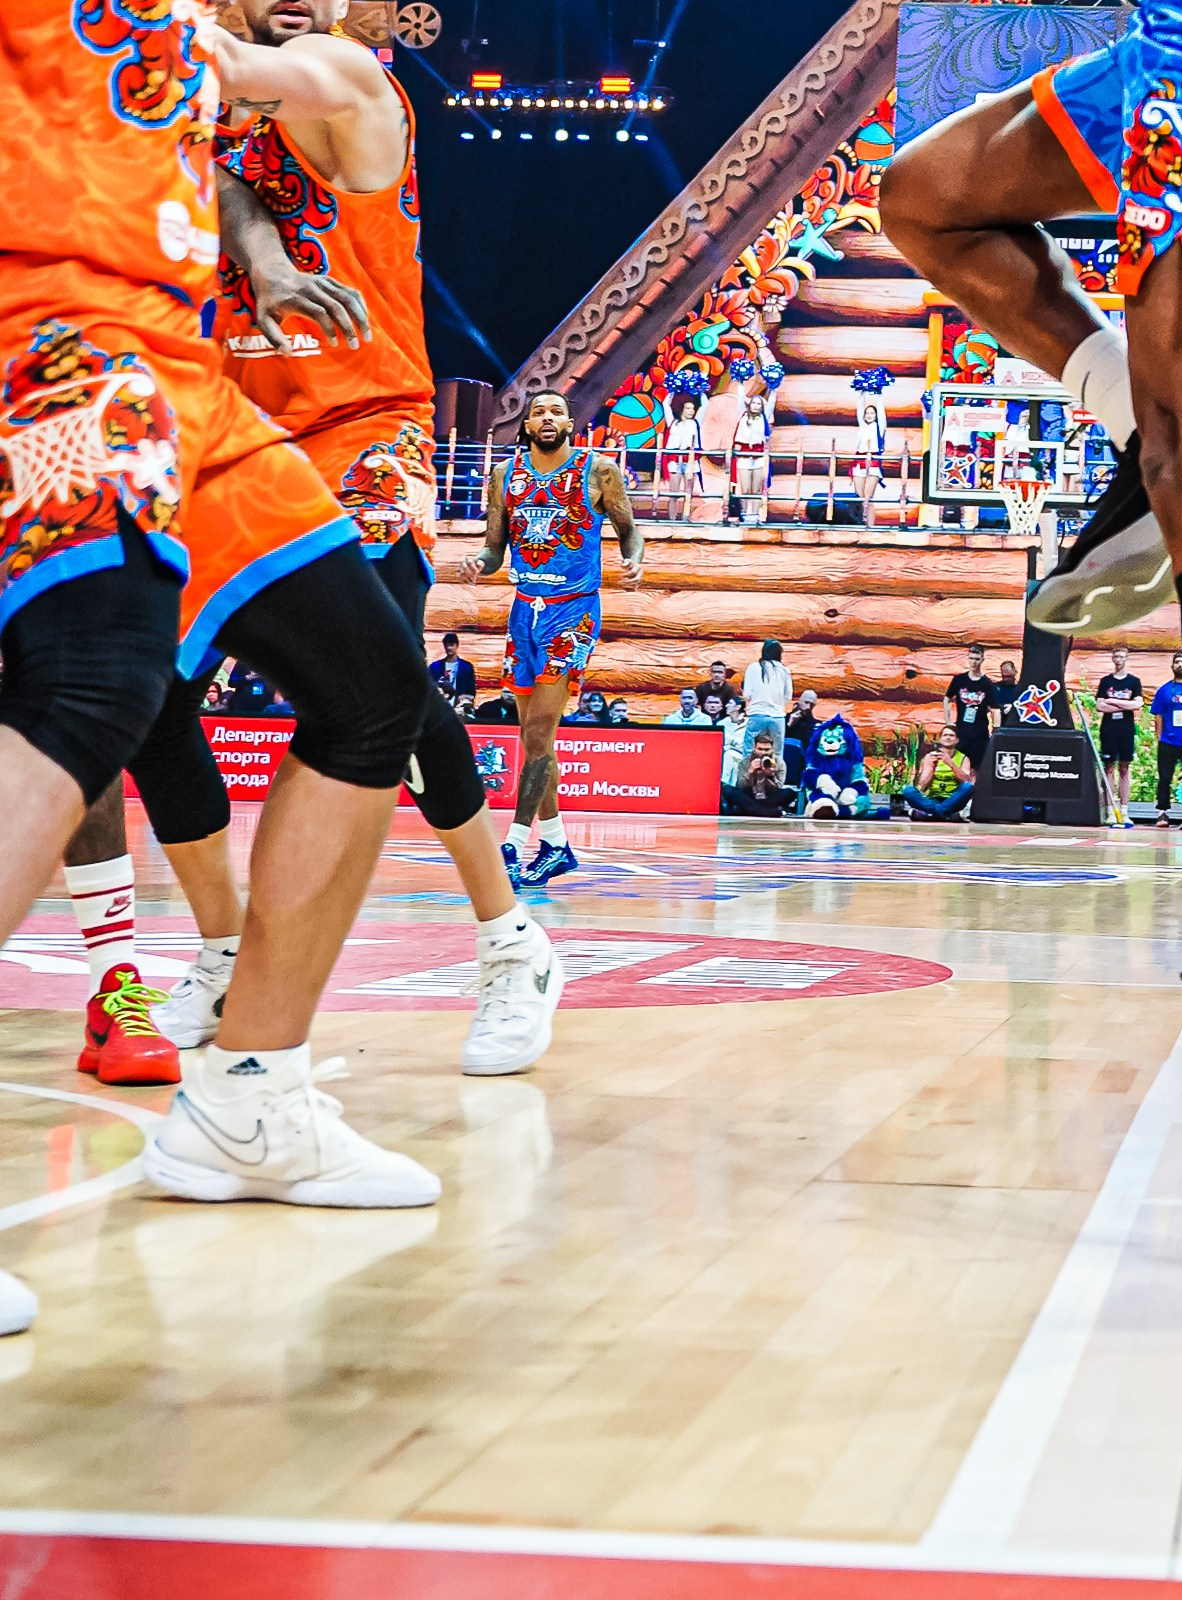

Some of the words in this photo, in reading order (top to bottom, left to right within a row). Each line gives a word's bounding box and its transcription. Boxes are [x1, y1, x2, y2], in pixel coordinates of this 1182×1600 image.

[565, 473, 573, 492] 1
[553, 740, 645, 756] партамент
[557, 762, 590, 776] рта
[557, 783, 588, 797] ода
[592, 781, 660, 797] Москвы
